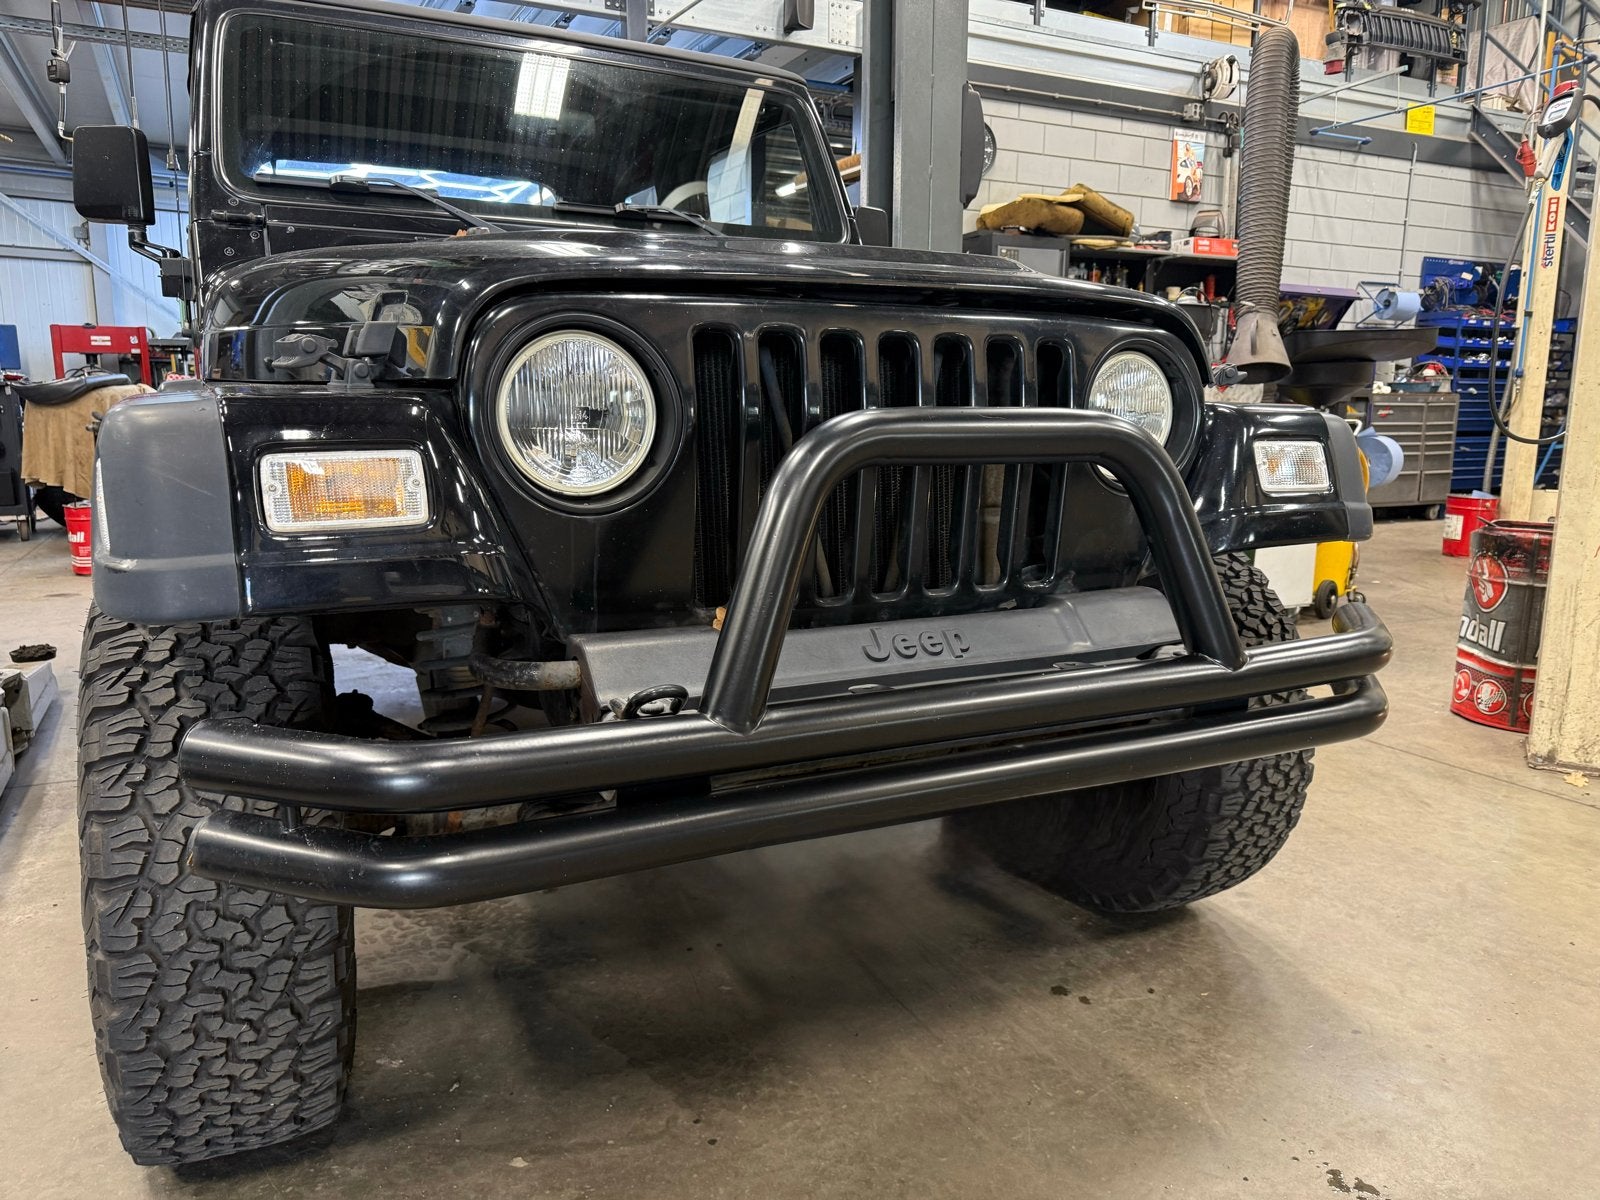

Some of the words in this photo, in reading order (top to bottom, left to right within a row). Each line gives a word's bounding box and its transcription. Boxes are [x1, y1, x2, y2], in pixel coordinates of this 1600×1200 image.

[1547, 198, 1559, 231] KONI
[1543, 233, 1556, 267] stertil
[862, 627, 970, 662] Jeep
